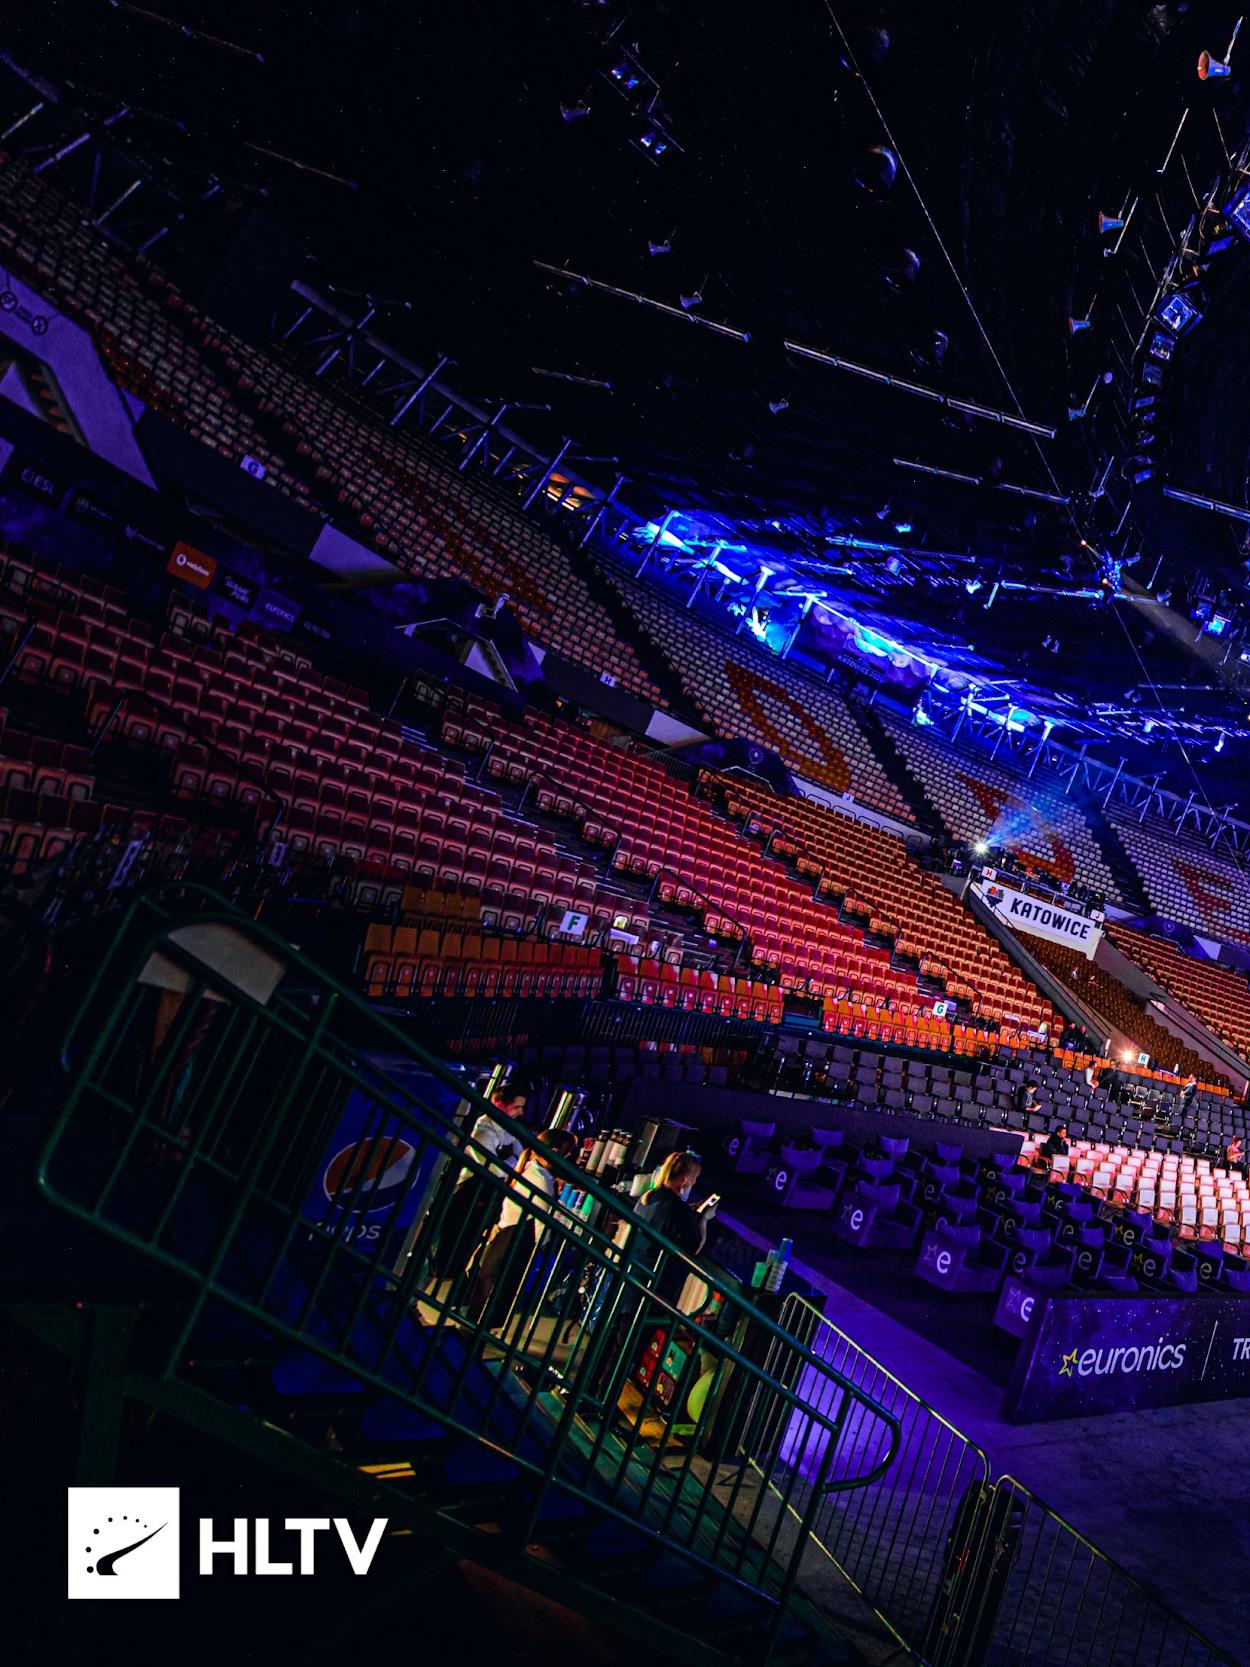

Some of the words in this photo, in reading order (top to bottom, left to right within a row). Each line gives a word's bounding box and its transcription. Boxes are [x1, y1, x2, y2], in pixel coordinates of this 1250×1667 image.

[247, 461, 259, 475] G
[567, 914, 581, 930] F
[1010, 898, 1090, 940] KATOWICE
[775, 1170, 788, 1191] e
[850, 1208, 864, 1231] e
[1123, 1228, 1136, 1246] e
[937, 1250, 952, 1274] e
[1077, 1249, 1094, 1271] e
[1143, 1257, 1157, 1278] e
[1200, 1260, 1213, 1280] e
[1077, 1336, 1187, 1377] euronics
